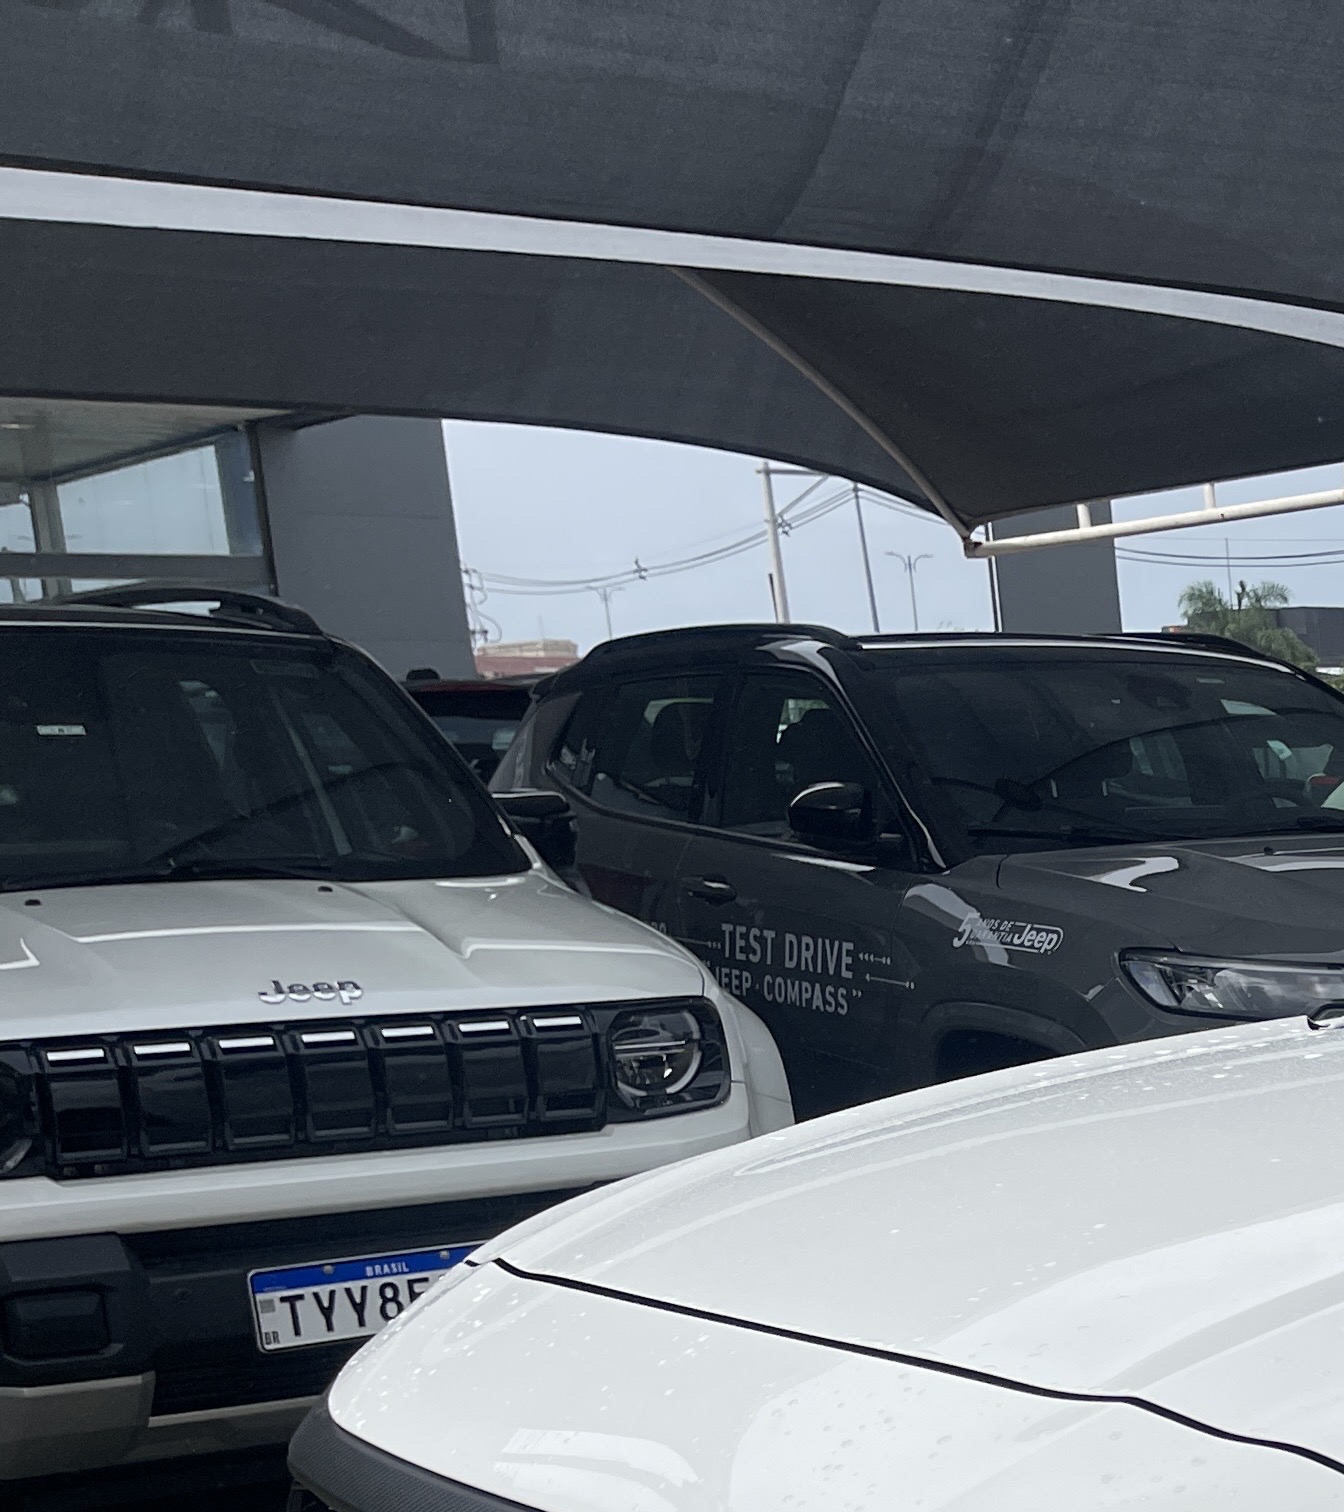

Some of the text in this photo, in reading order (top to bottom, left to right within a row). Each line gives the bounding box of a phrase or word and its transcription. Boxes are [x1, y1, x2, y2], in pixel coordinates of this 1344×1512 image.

[953, 912, 981, 948] 5
[1012, 923, 1059, 954] Jeep
[721, 922, 855, 979] TEST DRIVE
[258, 980, 362, 1005] Jeep
[763, 974, 849, 1016] COMPASS
[366, 1261, 410, 1277] BRASIL
[264, 1330, 281, 1346] BR
